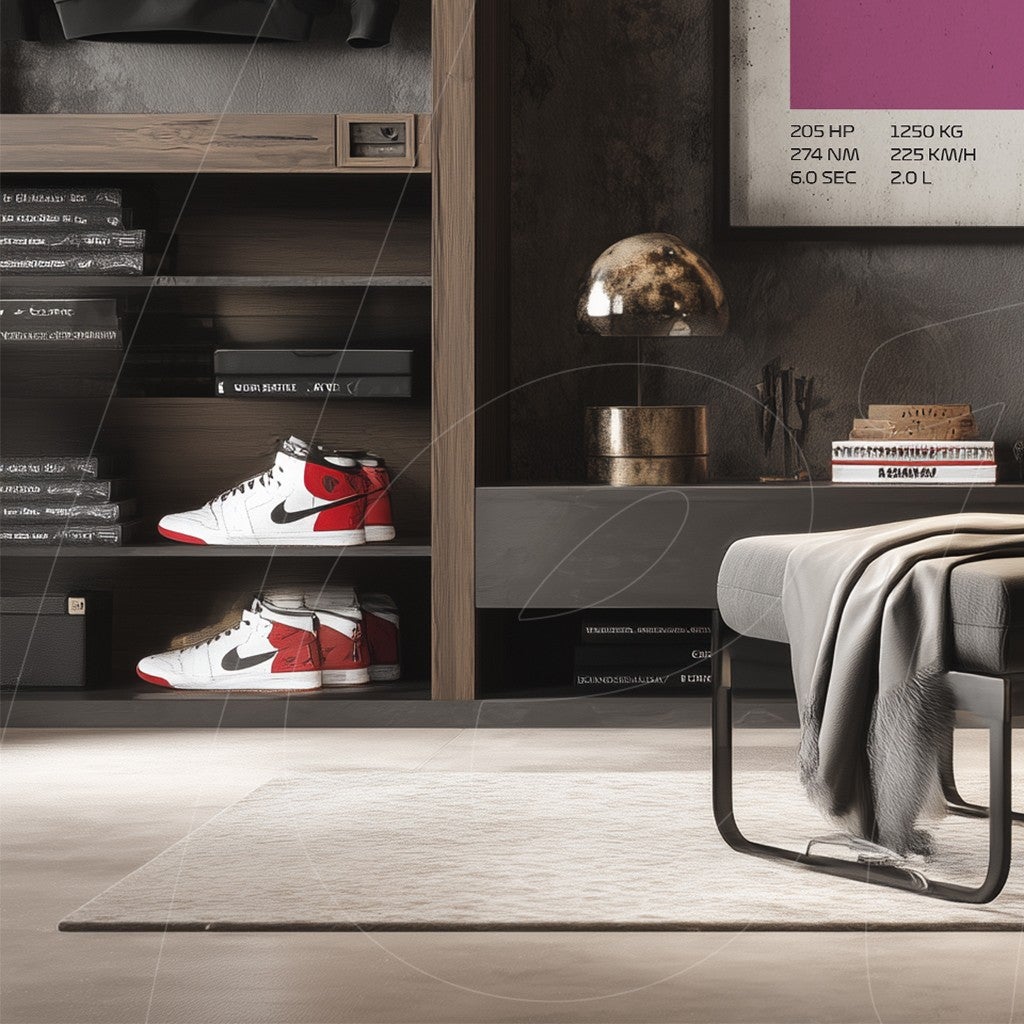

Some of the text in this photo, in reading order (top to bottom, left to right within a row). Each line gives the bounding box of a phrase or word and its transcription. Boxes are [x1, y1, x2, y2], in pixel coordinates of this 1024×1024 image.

[790, 124, 855, 138] 205 HP
[890, 124, 963, 138] 1250 KG
[790, 147, 860, 161] 274 NM
[890, 147, 976, 163] 225 KM/H
[790, 170, 857, 185] 6.0 SEC
[890, 170, 932, 185] 2.0 L
